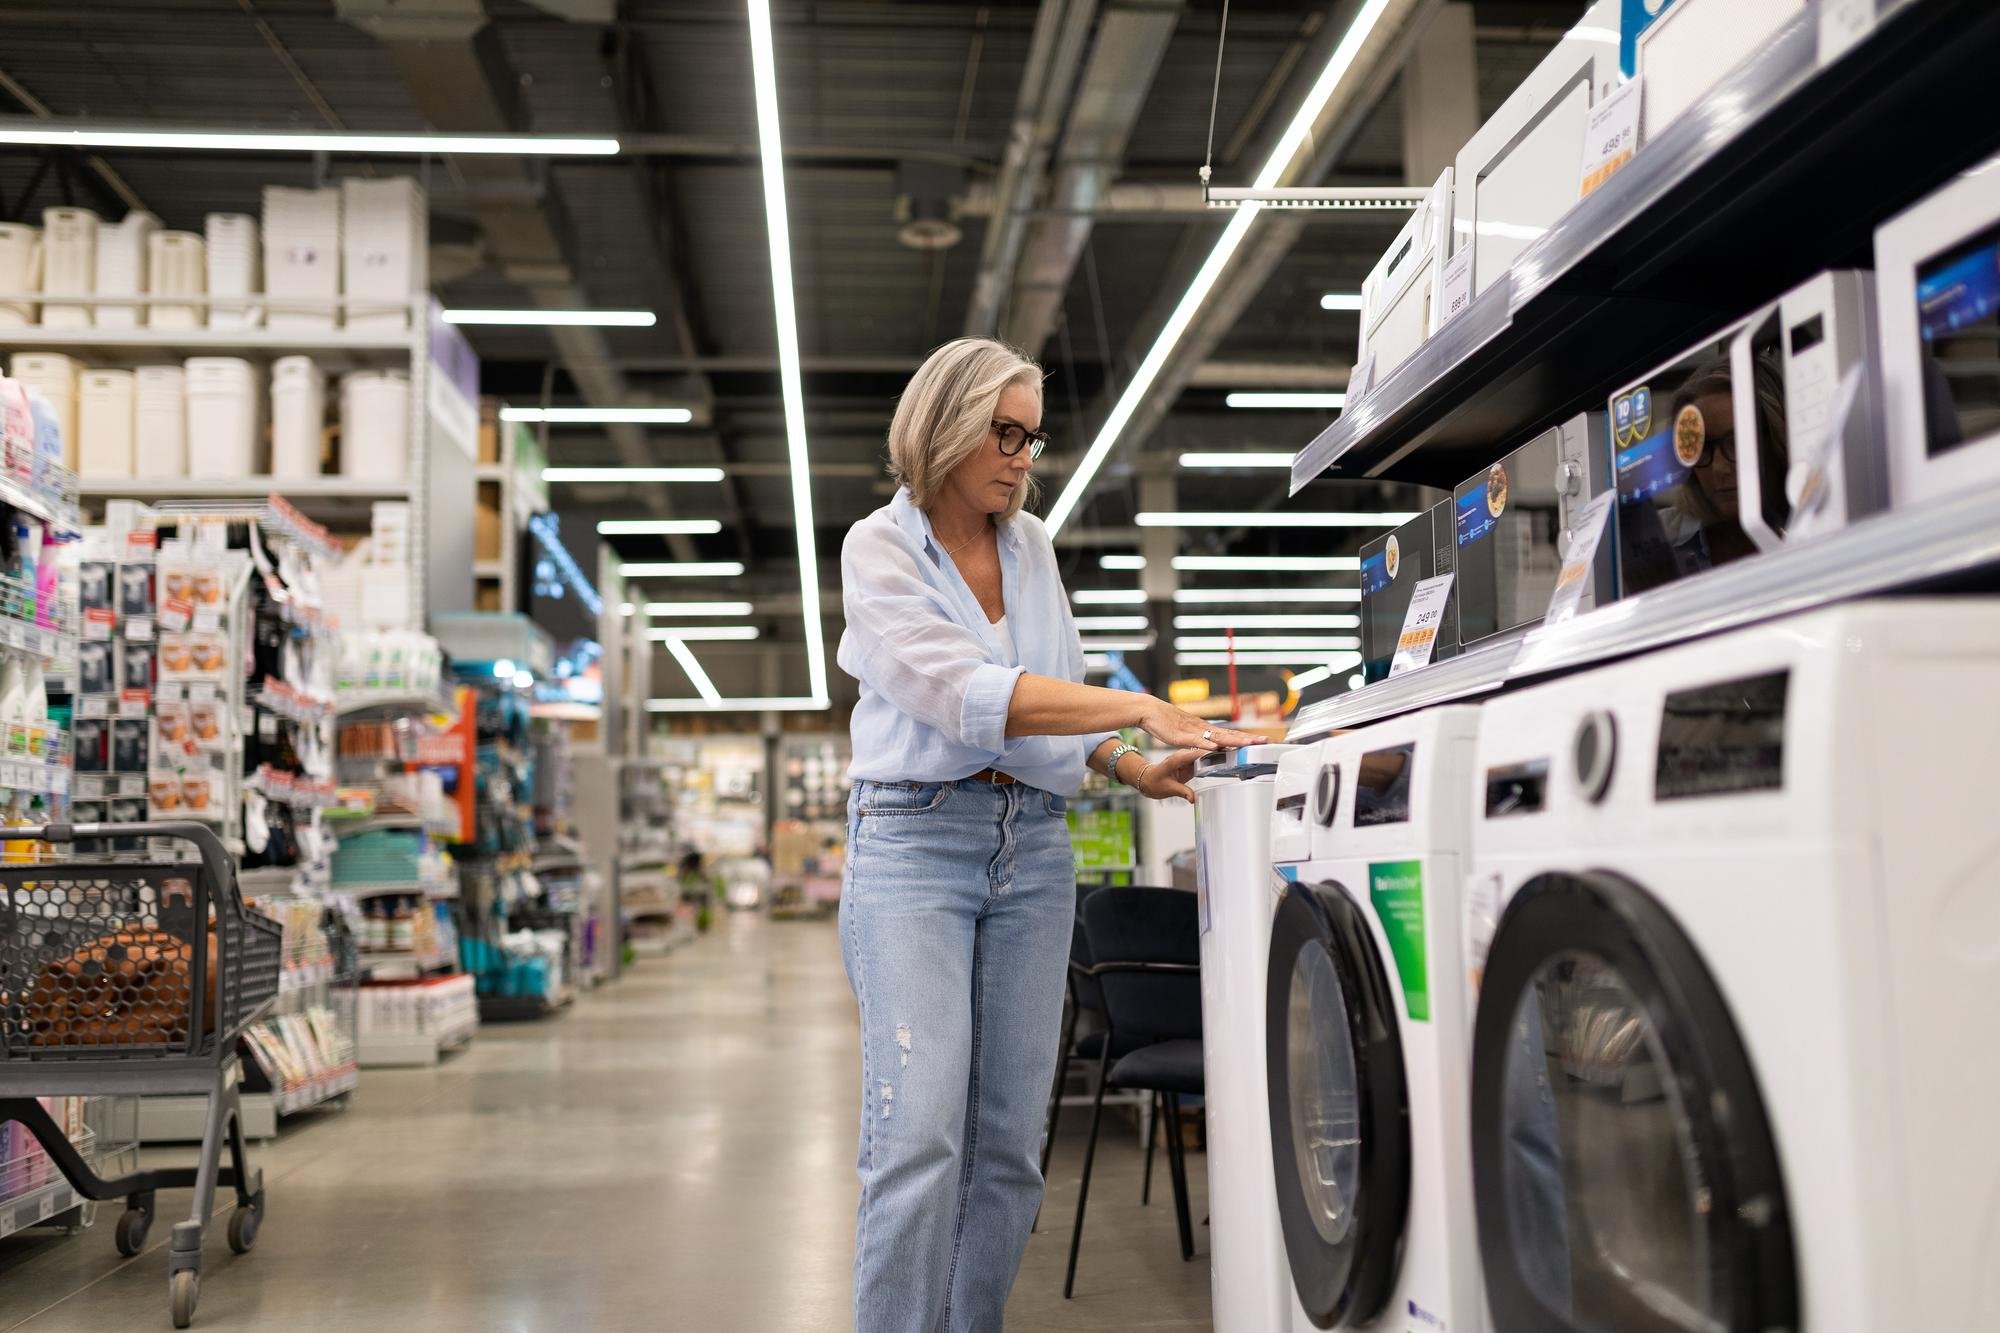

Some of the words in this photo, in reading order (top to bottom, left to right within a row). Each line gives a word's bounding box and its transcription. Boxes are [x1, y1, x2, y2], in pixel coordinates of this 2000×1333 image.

[1602, 134, 1620, 155] 498
[1618, 401, 1629, 418] 10
[1637, 392, 1645, 410] 2
[1416, 612, 1430, 625] 249
